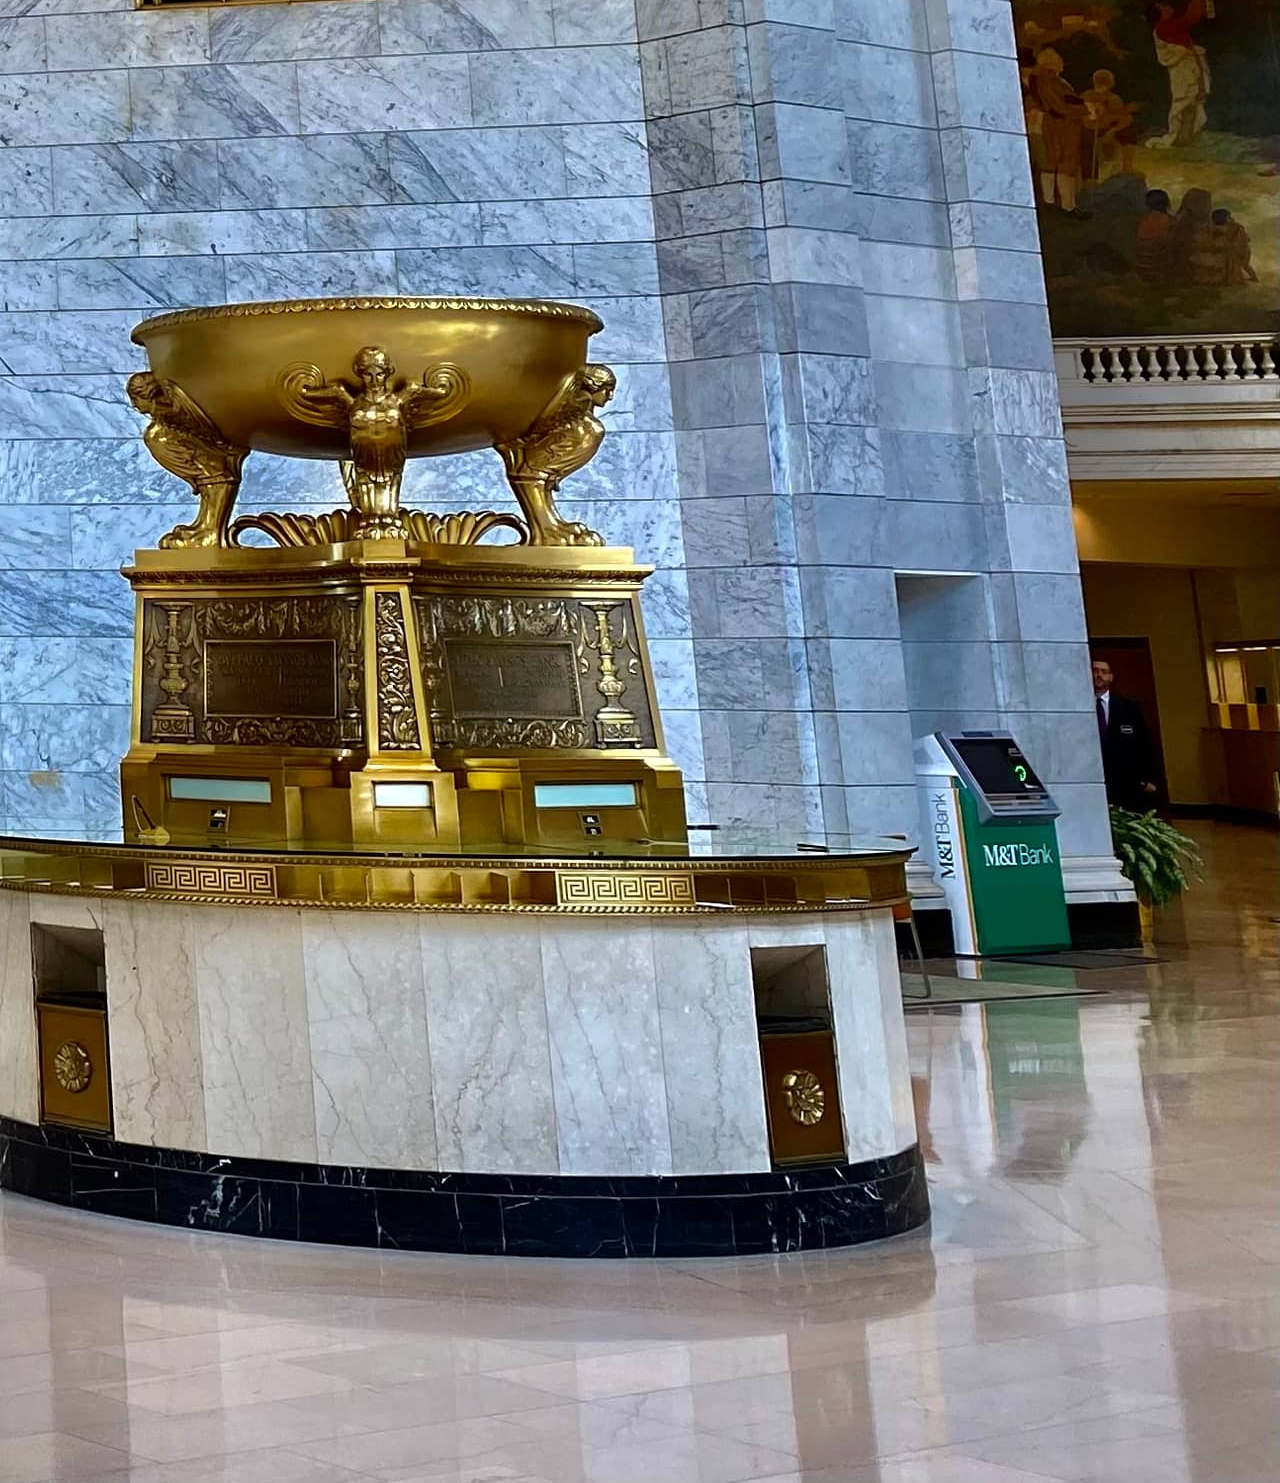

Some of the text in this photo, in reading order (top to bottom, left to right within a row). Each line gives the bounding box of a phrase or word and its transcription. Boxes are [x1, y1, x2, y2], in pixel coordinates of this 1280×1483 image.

[931, 793, 956, 879] M&T Bank
[983, 843, 1054, 867] M&T Bank
